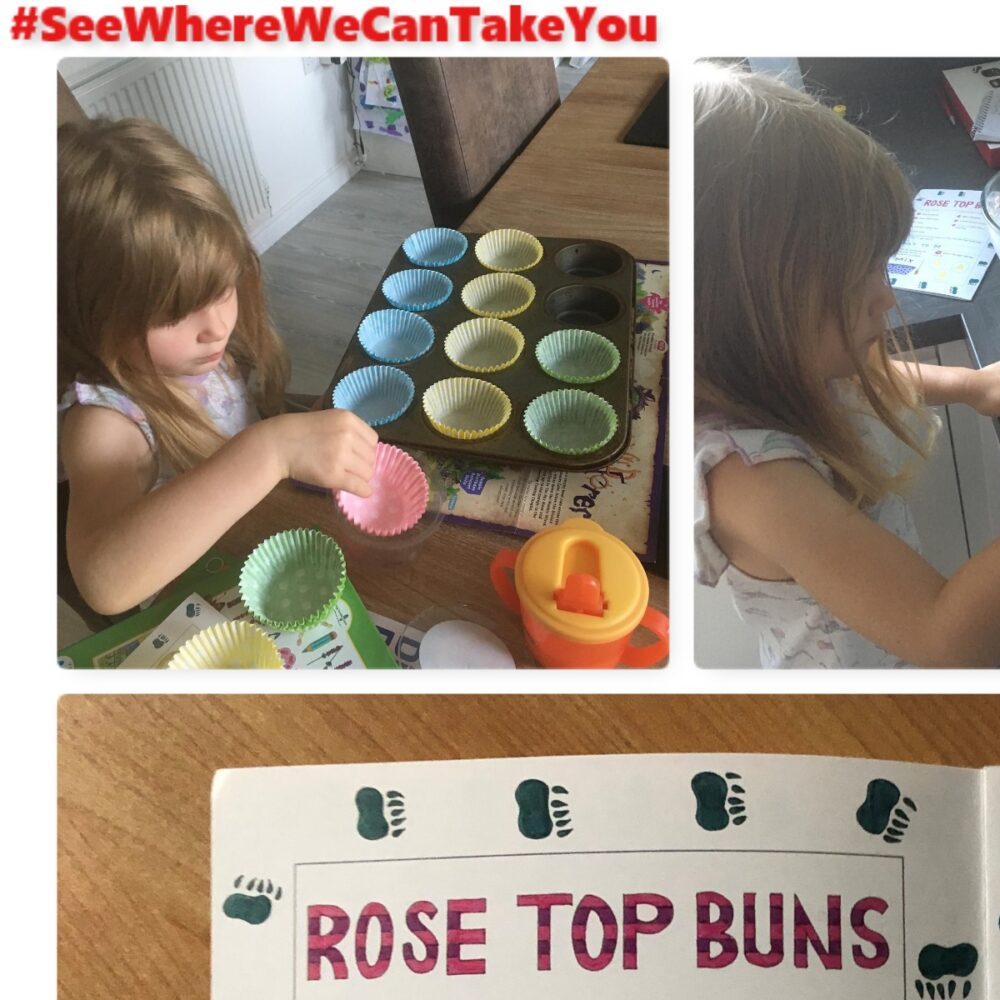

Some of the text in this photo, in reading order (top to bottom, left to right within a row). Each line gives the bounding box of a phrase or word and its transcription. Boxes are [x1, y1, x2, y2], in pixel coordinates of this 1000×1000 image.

[923, 199, 951, 208] ROSE
[953, 200, 974, 209] TOP
[306, 890, 890, 981] ROSE TOP BUNS
